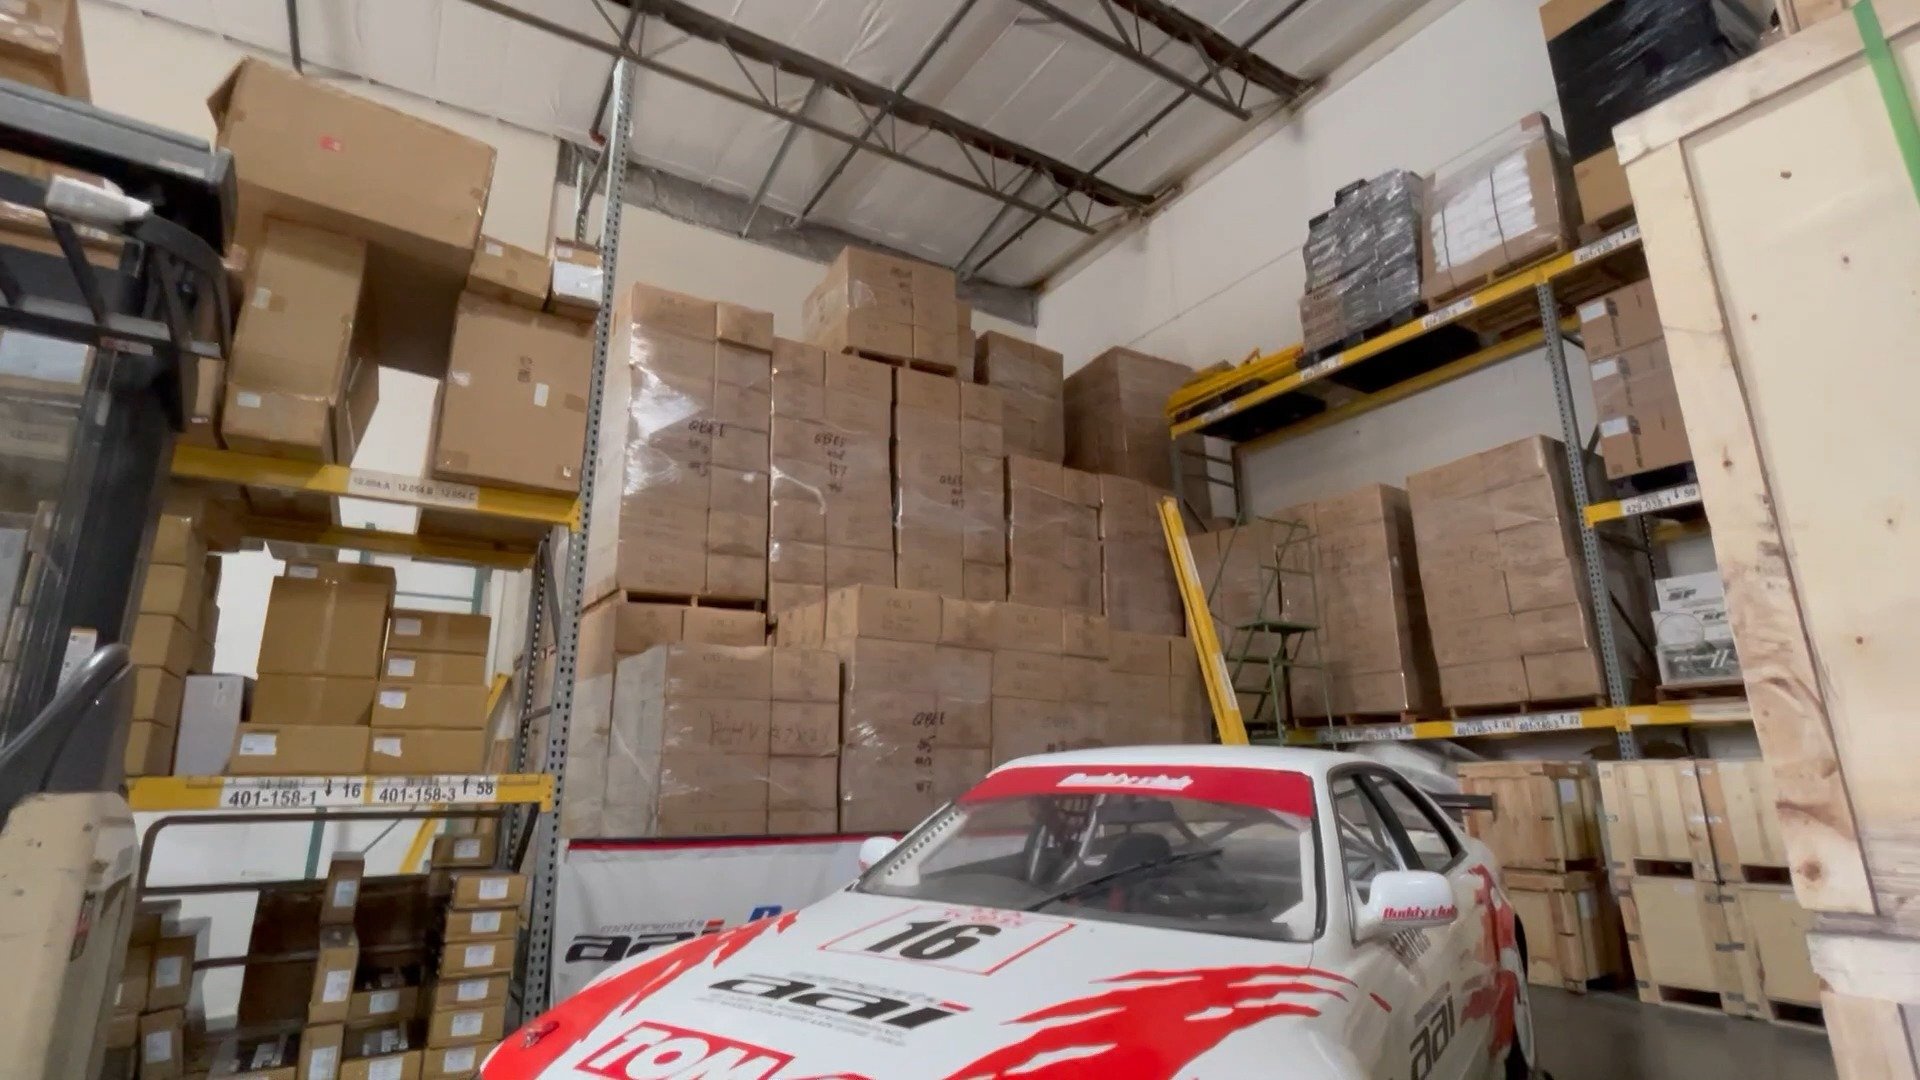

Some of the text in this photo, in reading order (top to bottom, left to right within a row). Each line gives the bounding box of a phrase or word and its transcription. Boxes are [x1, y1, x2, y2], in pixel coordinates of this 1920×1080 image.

[228, 783, 362, 807] 401-158-1 16
[379, 780, 494, 802] 401-158-3 58
[864, 910, 1001, 960] 16
[708, 973, 973, 1030] aai
